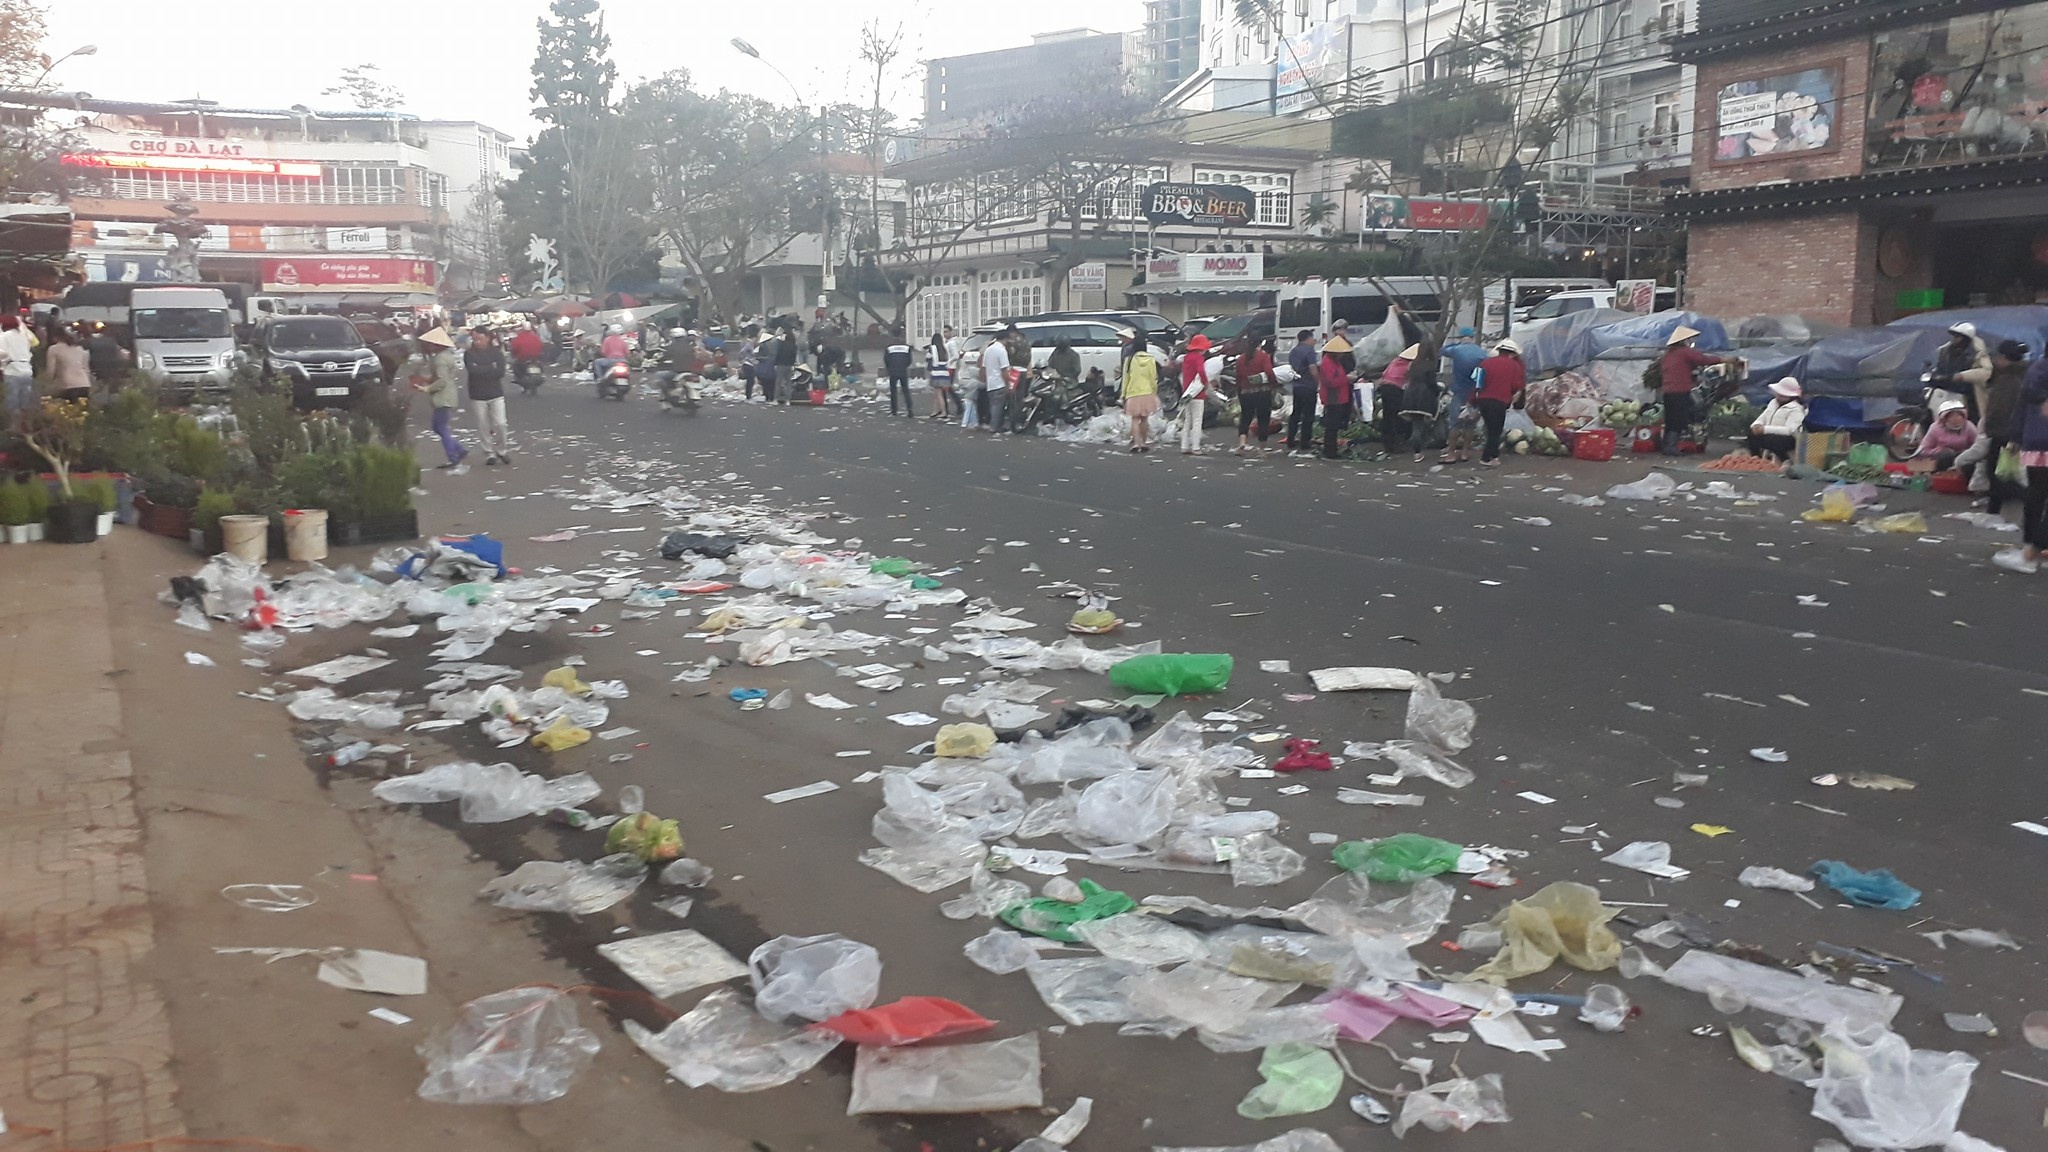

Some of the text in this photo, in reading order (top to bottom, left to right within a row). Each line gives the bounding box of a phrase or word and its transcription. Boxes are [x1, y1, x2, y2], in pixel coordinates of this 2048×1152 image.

[130, 140, 244, 157] CHỢ ĐÀ LẠT
[1160, 185, 1204, 195] PREMIUM
[1151, 194, 1195, 220] BBQ
[341, 231, 370, 244] Ferroli
